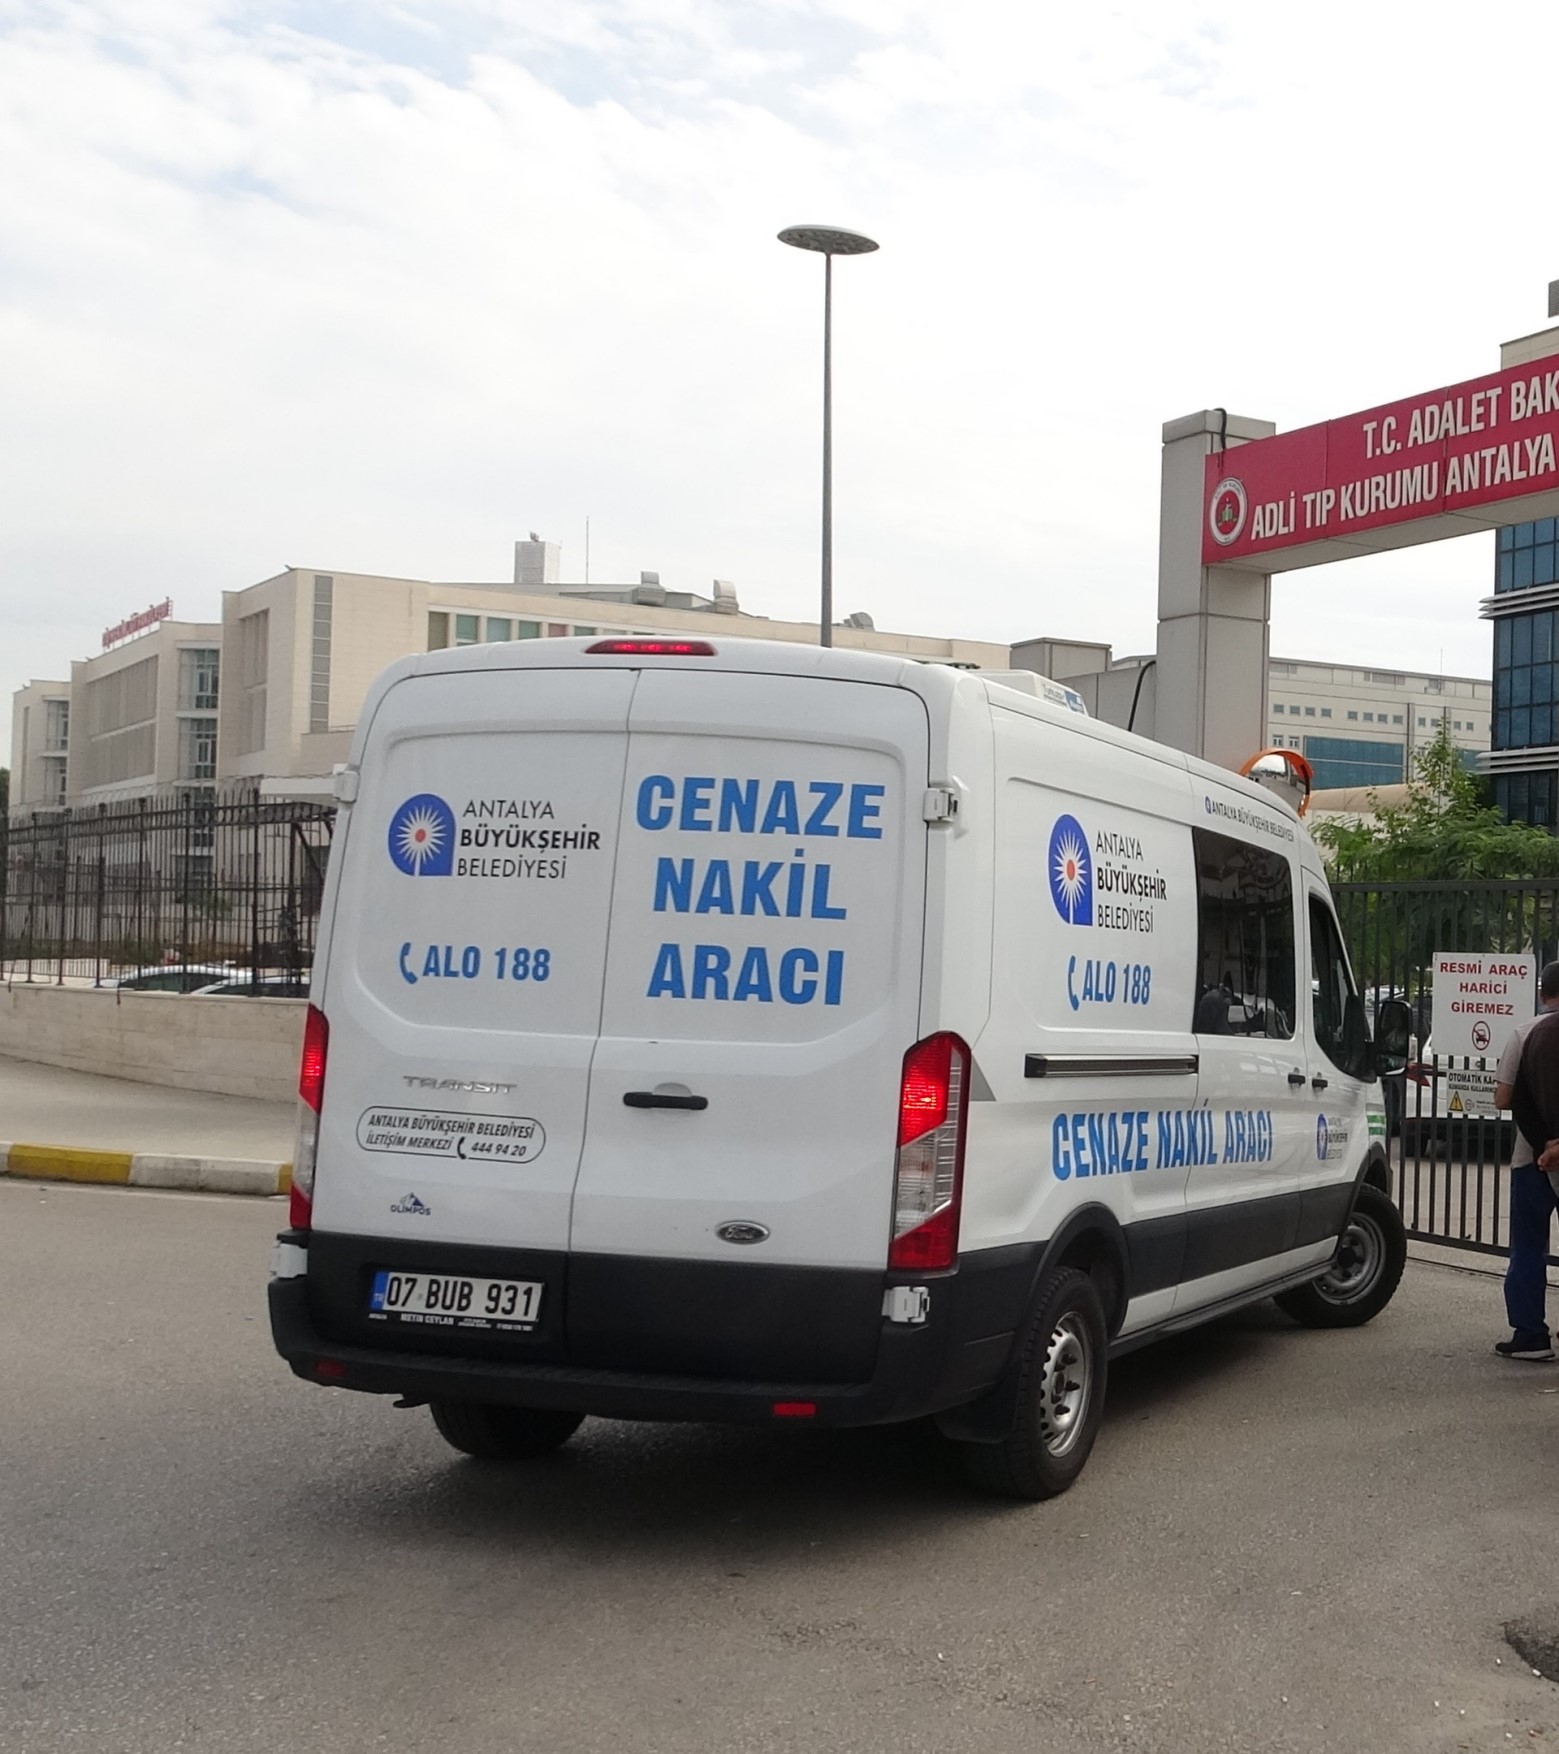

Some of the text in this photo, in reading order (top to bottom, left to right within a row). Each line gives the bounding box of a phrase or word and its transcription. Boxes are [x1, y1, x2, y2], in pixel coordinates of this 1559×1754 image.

[1363, 420, 1402, 459] T.C.
[1408, 387, 1502, 445] ADALET
[1251, 497, 1296, 541] ADLİ
[1302, 489, 1335, 529] TIP
[1340, 461, 1438, 521] KURUMU
[1445, 436, 1556, 496] ANTALYA
[463, 800, 555, 820] ANTALYA
[635, 775, 885, 840] CENAZE
[460, 824, 601, 851] BÜYÜKŞEHİR
[1096, 829, 1144, 861] ANTALYA
[456, 854, 567, 880] BELEDİYESİ
[1097, 861, 1167, 902] BÜYÜKŞEHİR
[653, 847, 848, 921] NAKİL
[1097, 902, 1154, 933] BELEDİYESİ
[422, 945, 551, 982] ALO 188
[646, 943, 846, 1006] ARACI
[1440, 960, 1528, 980] RESMİ ARAÇ
[1082, 959, 1152, 1006] ALO 188
[1459, 980, 1507, 995] HARİCİ
[1451, 1000, 1514, 1016] GİREMEZ
[403, 1075, 518, 1094] TRANSIT
[1449, 1072, 1482, 1084] OTOMATİK
[368, 1114, 535, 1139] ANTALYA BÜYÜKŞEHİR BELEDİYESİ
[1052, 1098, 1273, 1181] CENAZE NAKİL ARACI
[366, 1130, 526, 1157] İLETİŞİM MERKEZİ 444 94 20
[386, 1276, 533, 1317] 07 BUB 931
